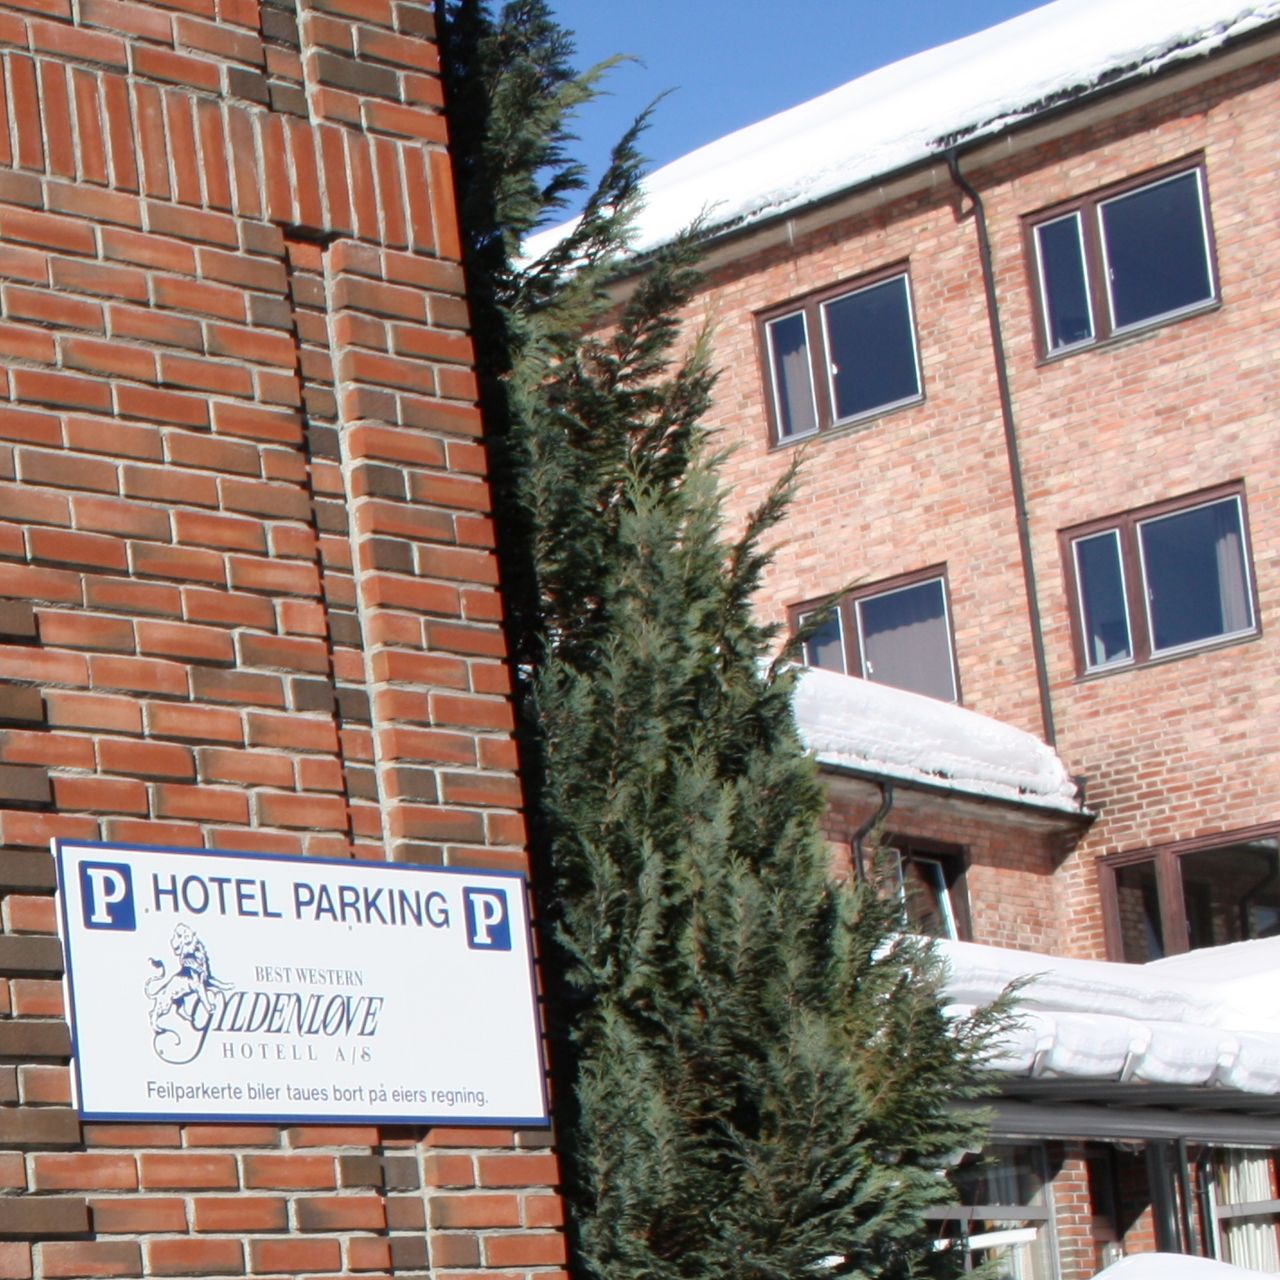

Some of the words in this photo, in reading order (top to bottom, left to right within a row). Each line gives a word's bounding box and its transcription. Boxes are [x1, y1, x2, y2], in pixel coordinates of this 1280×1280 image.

[86, 867, 127, 925] P
[151, 873, 283, 919] HOTEL
[292, 881, 451, 929] PARKING
[468, 892, 504, 945] P
[255, 965, 292, 984] BEST
[295, 967, 364, 987] WESTERN
[153, 988, 385, 1066] GYLDENLØVE
[221, 1042, 319, 1062] HOTELL
[335, 1045, 372, 1066] A/S
[146, 1080, 243, 1104] Feilparkerte
[246, 1082, 281, 1102] biler
[286, 1084, 329, 1102] taues
[332, 1083, 364, 1102] bort
[368, 1083, 388, 1106] på
[391, 1085, 428, 1103] eiers
[431, 1086, 489, 1107] regning.
